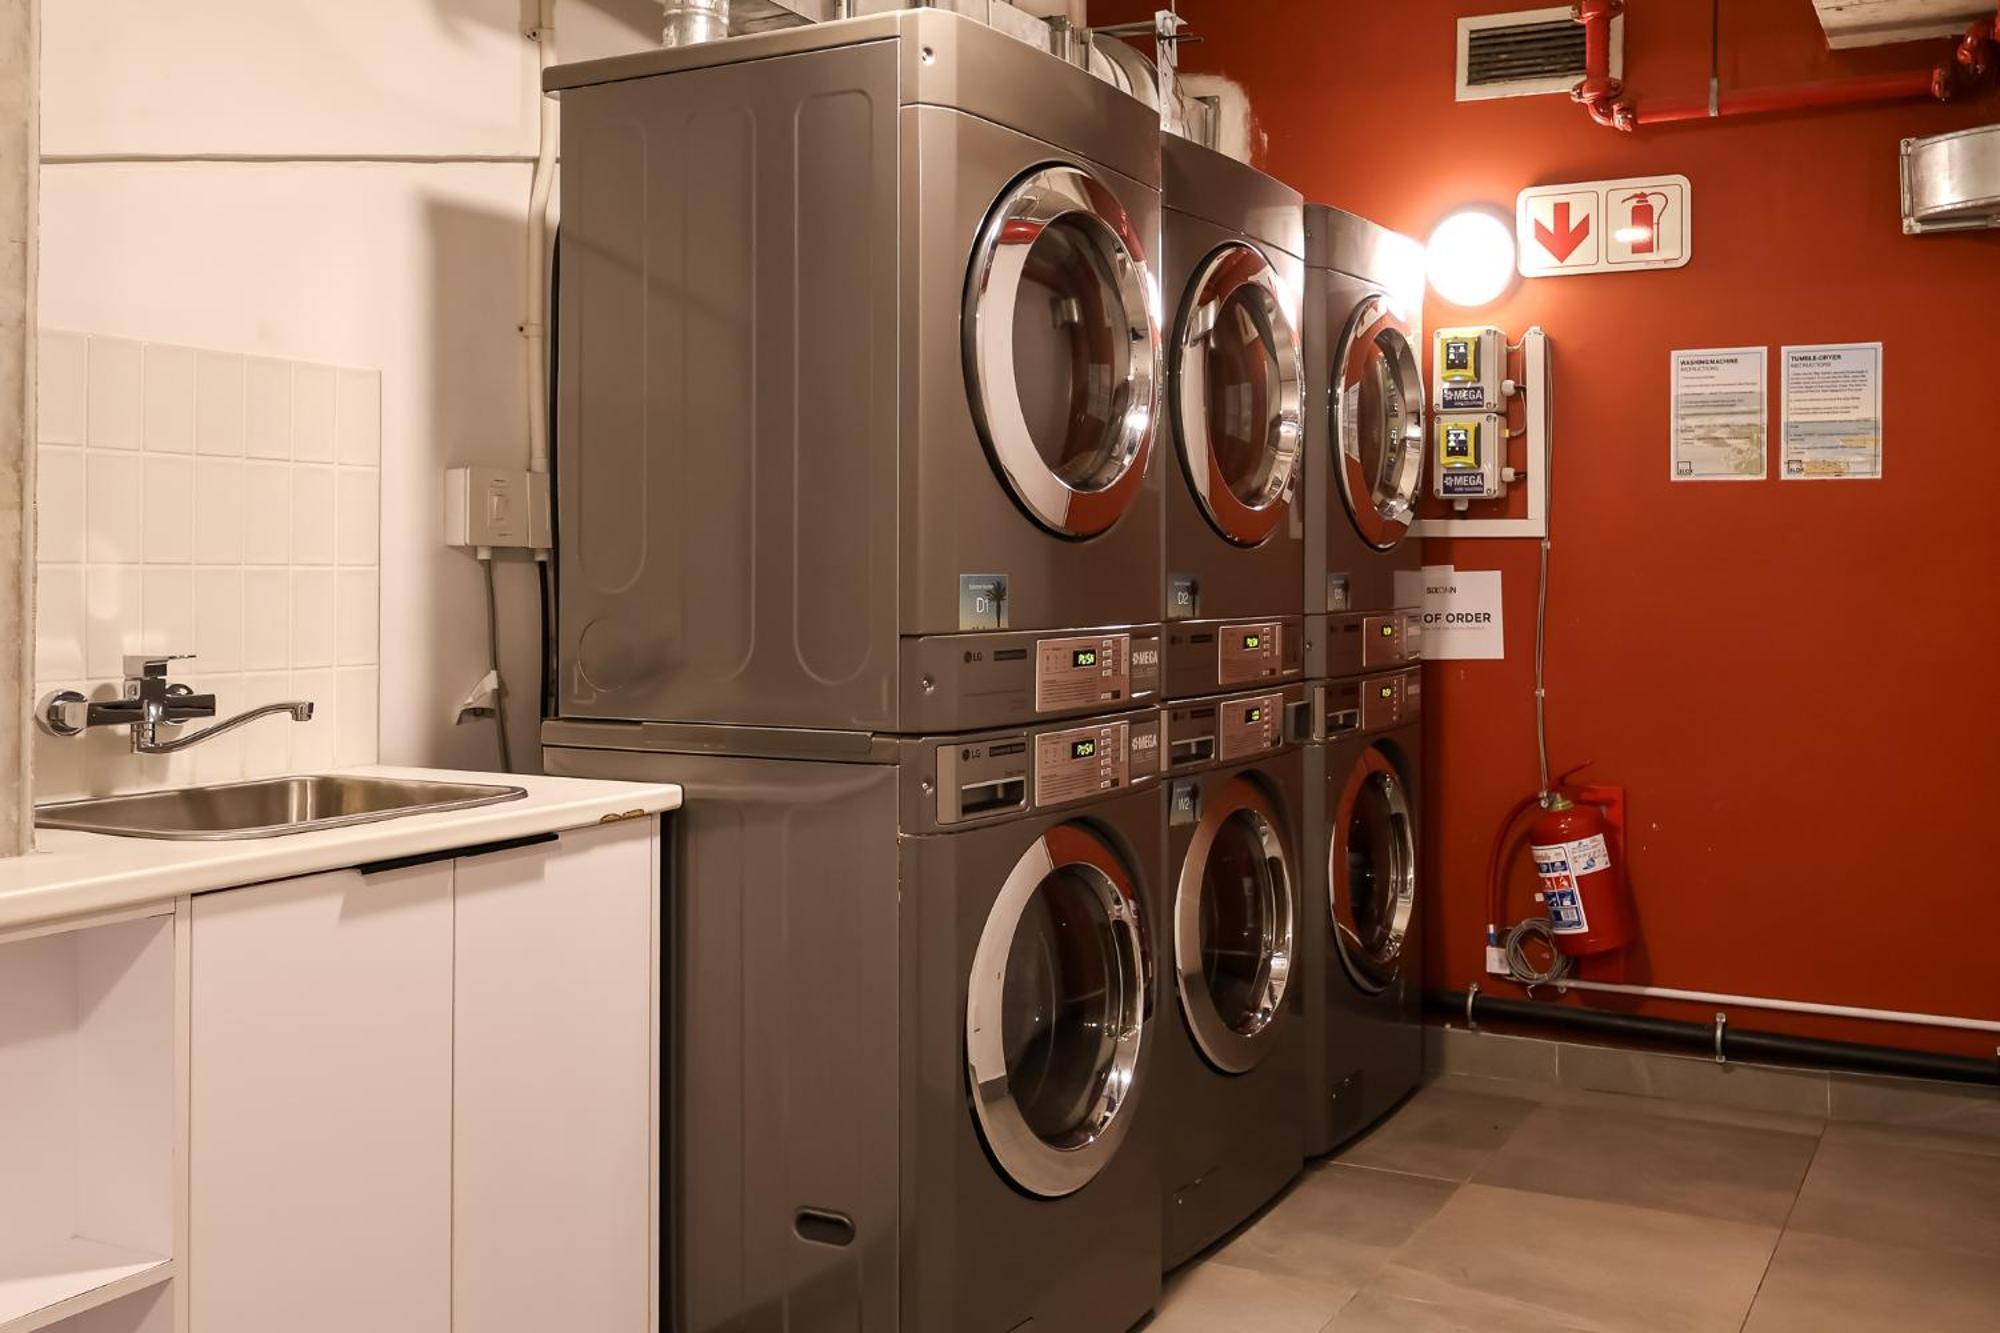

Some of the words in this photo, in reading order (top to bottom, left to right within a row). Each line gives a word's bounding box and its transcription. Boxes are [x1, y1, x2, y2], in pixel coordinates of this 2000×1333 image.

[1454, 389, 1483, 401] MEGA
[1454, 474, 1483, 487] MEGA
[976, 596, 989, 613] D1
[1178, 591, 1189, 605] D2
[1423, 613, 1442, 624] OF
[1446, 612, 1492, 624] ORDER
[1138, 650, 1158, 666] MEGA
[1137, 734, 1157, 751] MEGA
[1178, 798, 1189, 811] W2
